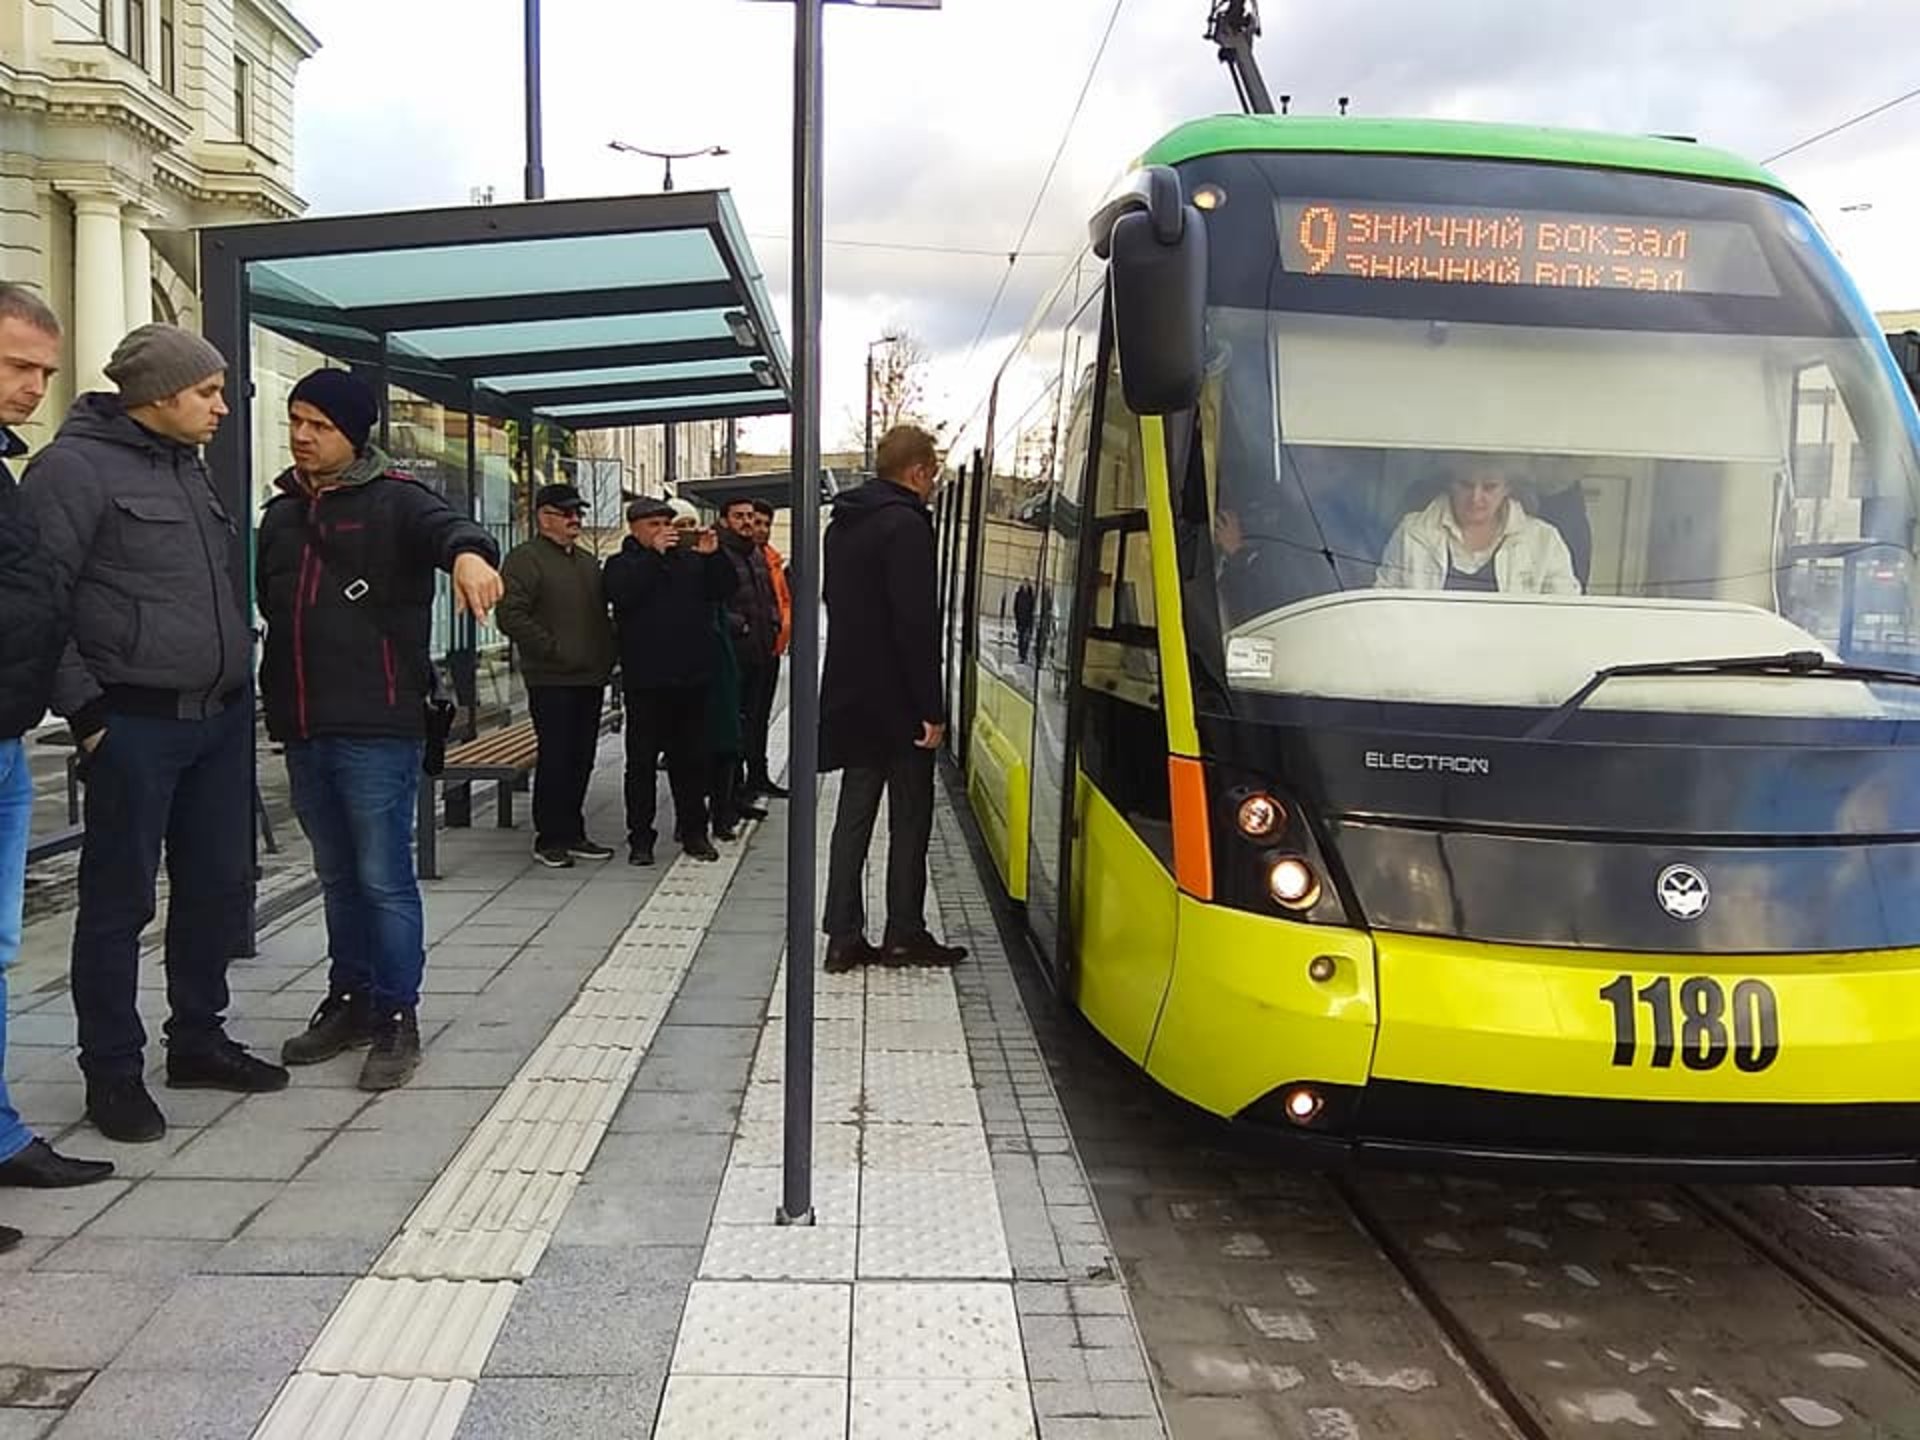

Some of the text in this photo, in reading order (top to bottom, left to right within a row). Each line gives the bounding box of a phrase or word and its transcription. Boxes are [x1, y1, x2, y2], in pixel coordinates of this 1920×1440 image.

[1299, 206, 1337, 275] 9
[1348, 213, 1523, 250] ЗНИЧНИЙ
[1365, 751, 1489, 774] ELECTRON
[1600, 975, 1779, 1073] 1180
